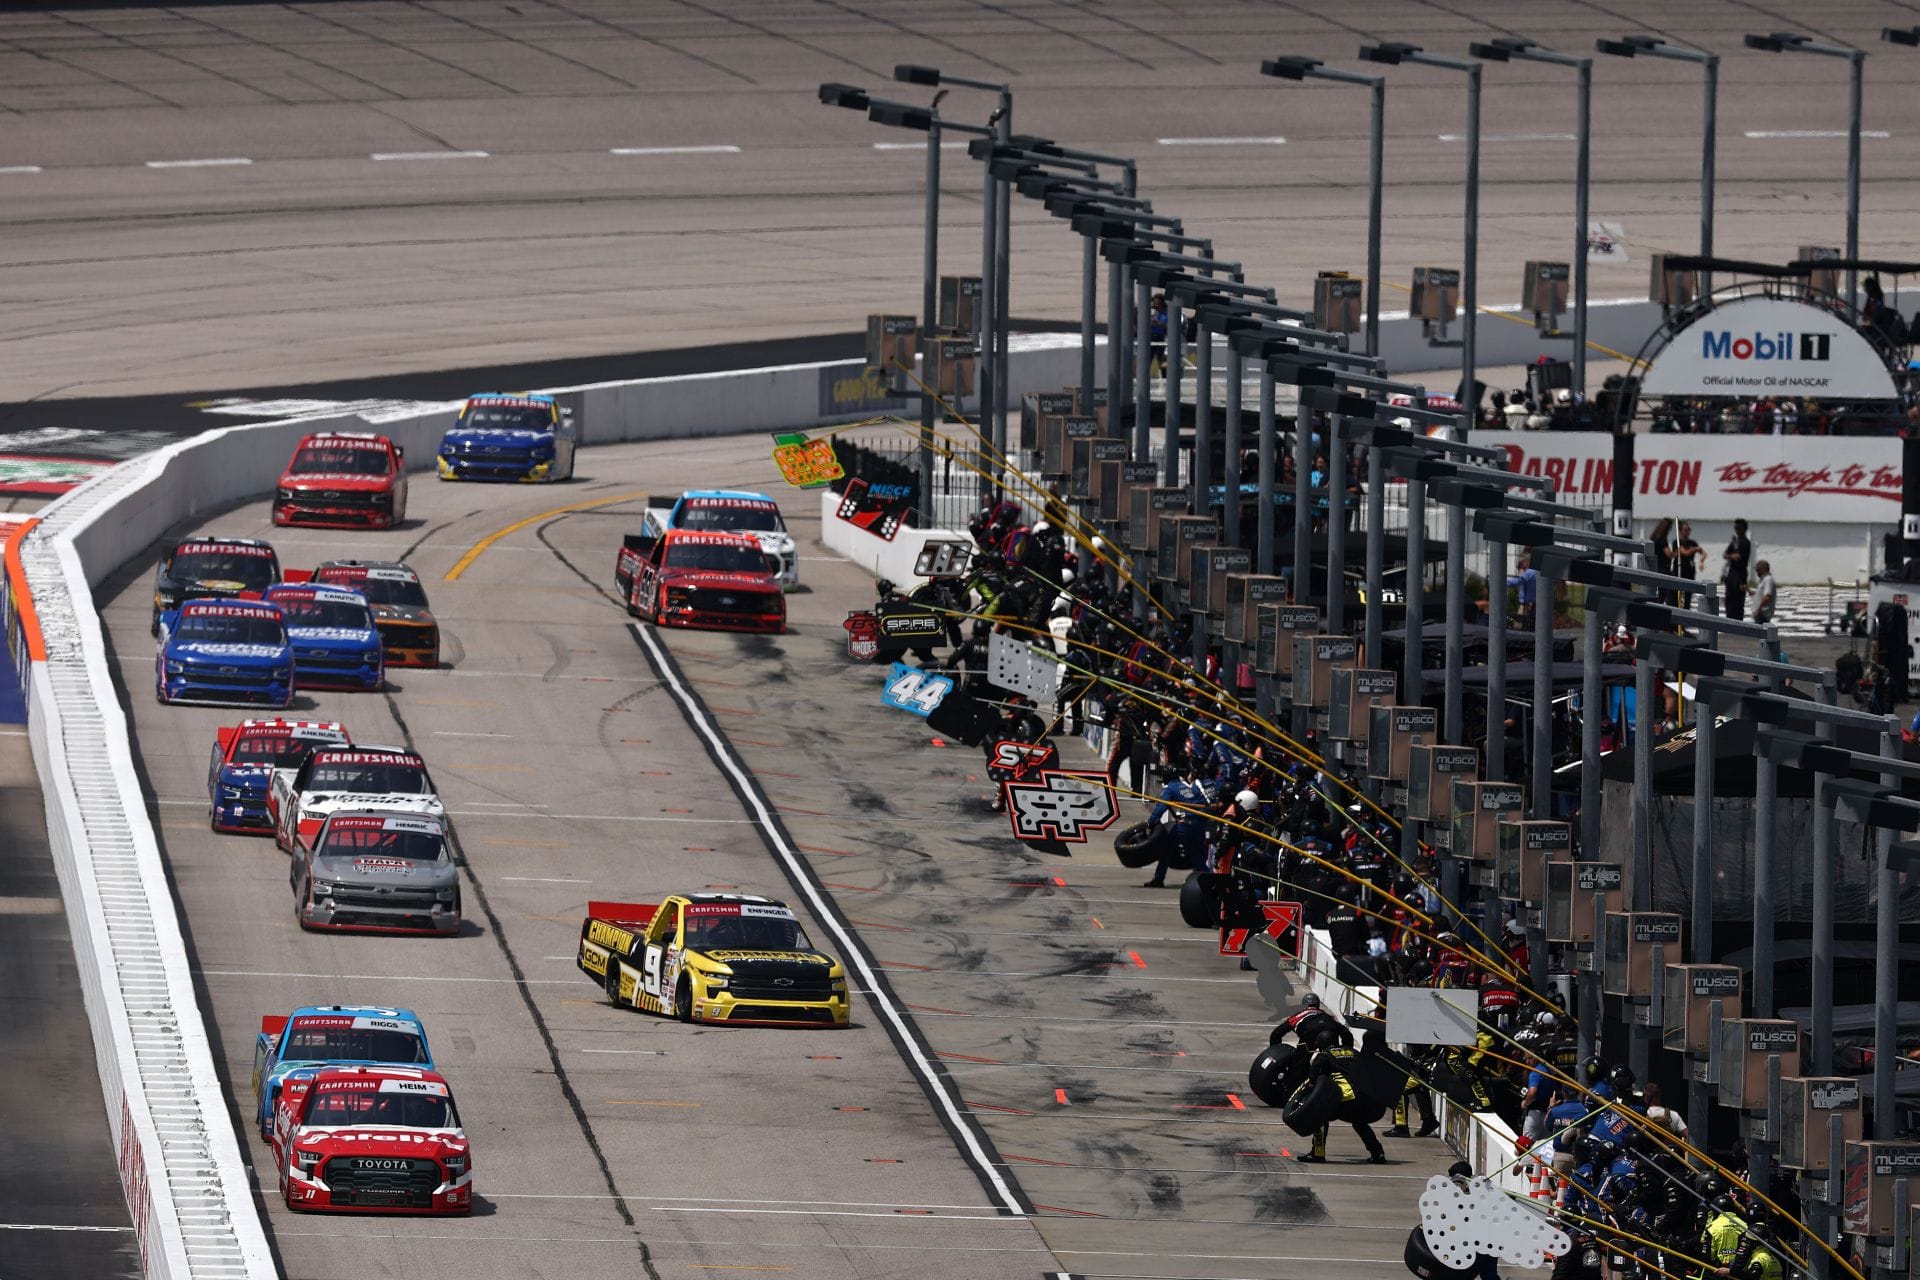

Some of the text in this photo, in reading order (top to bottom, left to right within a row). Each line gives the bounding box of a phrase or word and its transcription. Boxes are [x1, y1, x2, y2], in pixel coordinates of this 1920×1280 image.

[1703, 331, 1793, 360] Mobil
[1703, 376, 1733, 386] Official
[1789, 377, 1829, 387] NASCAR
[1714, 461, 1753, 483] too
[1762, 462, 1832, 496] tough
[1836, 463, 1868, 487] to
[692, 499, 770, 510] CRAFTSMAN
[674, 537, 752, 548] CRAFTSMAN
[184, 544, 266, 556] CRAFTSMAN
[190, 606, 274, 619] CRAFTSMAN
[888, 672, 950, 711] 44
[301, 730, 337, 739] ANKRUM
[320, 753, 415, 765] CRAFTSMAN
[395, 822, 428, 830] HEMRIC
[747, 908, 787, 916] ENFINGER
[589, 921, 635, 955] CHAMPION
[585, 949, 606, 968] GCM
[645, 945, 662, 997] 9
[370, 1021, 399, 1029] RIGGS
[319, 1081, 427, 1091] CRAFTSMAN HEIM
[358, 1160, 408, 1169] TOYOTA
[305, 1189, 316, 1199] 11
